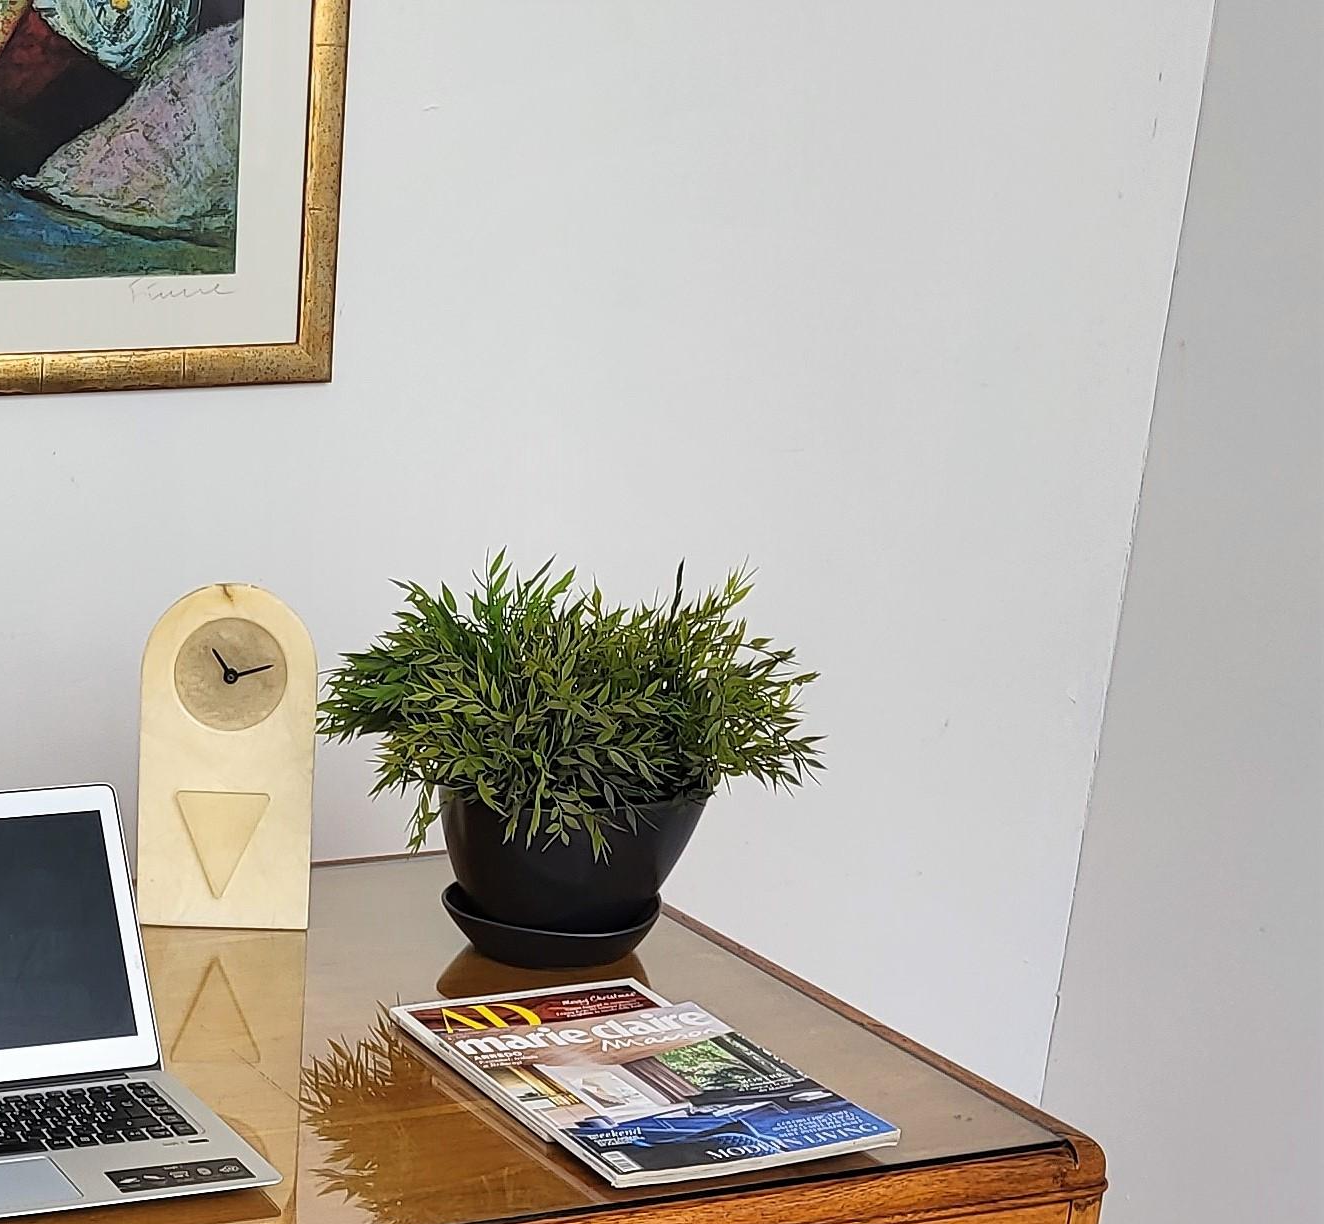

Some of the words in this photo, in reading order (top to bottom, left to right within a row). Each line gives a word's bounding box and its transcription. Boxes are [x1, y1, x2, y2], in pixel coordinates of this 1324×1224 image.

[441, 1003, 542, 1034] AD
[454, 1026, 595, 1056] marie
[590, 1011, 715, 1041] claire
[803, 1122, 879, 1145] LIVING
